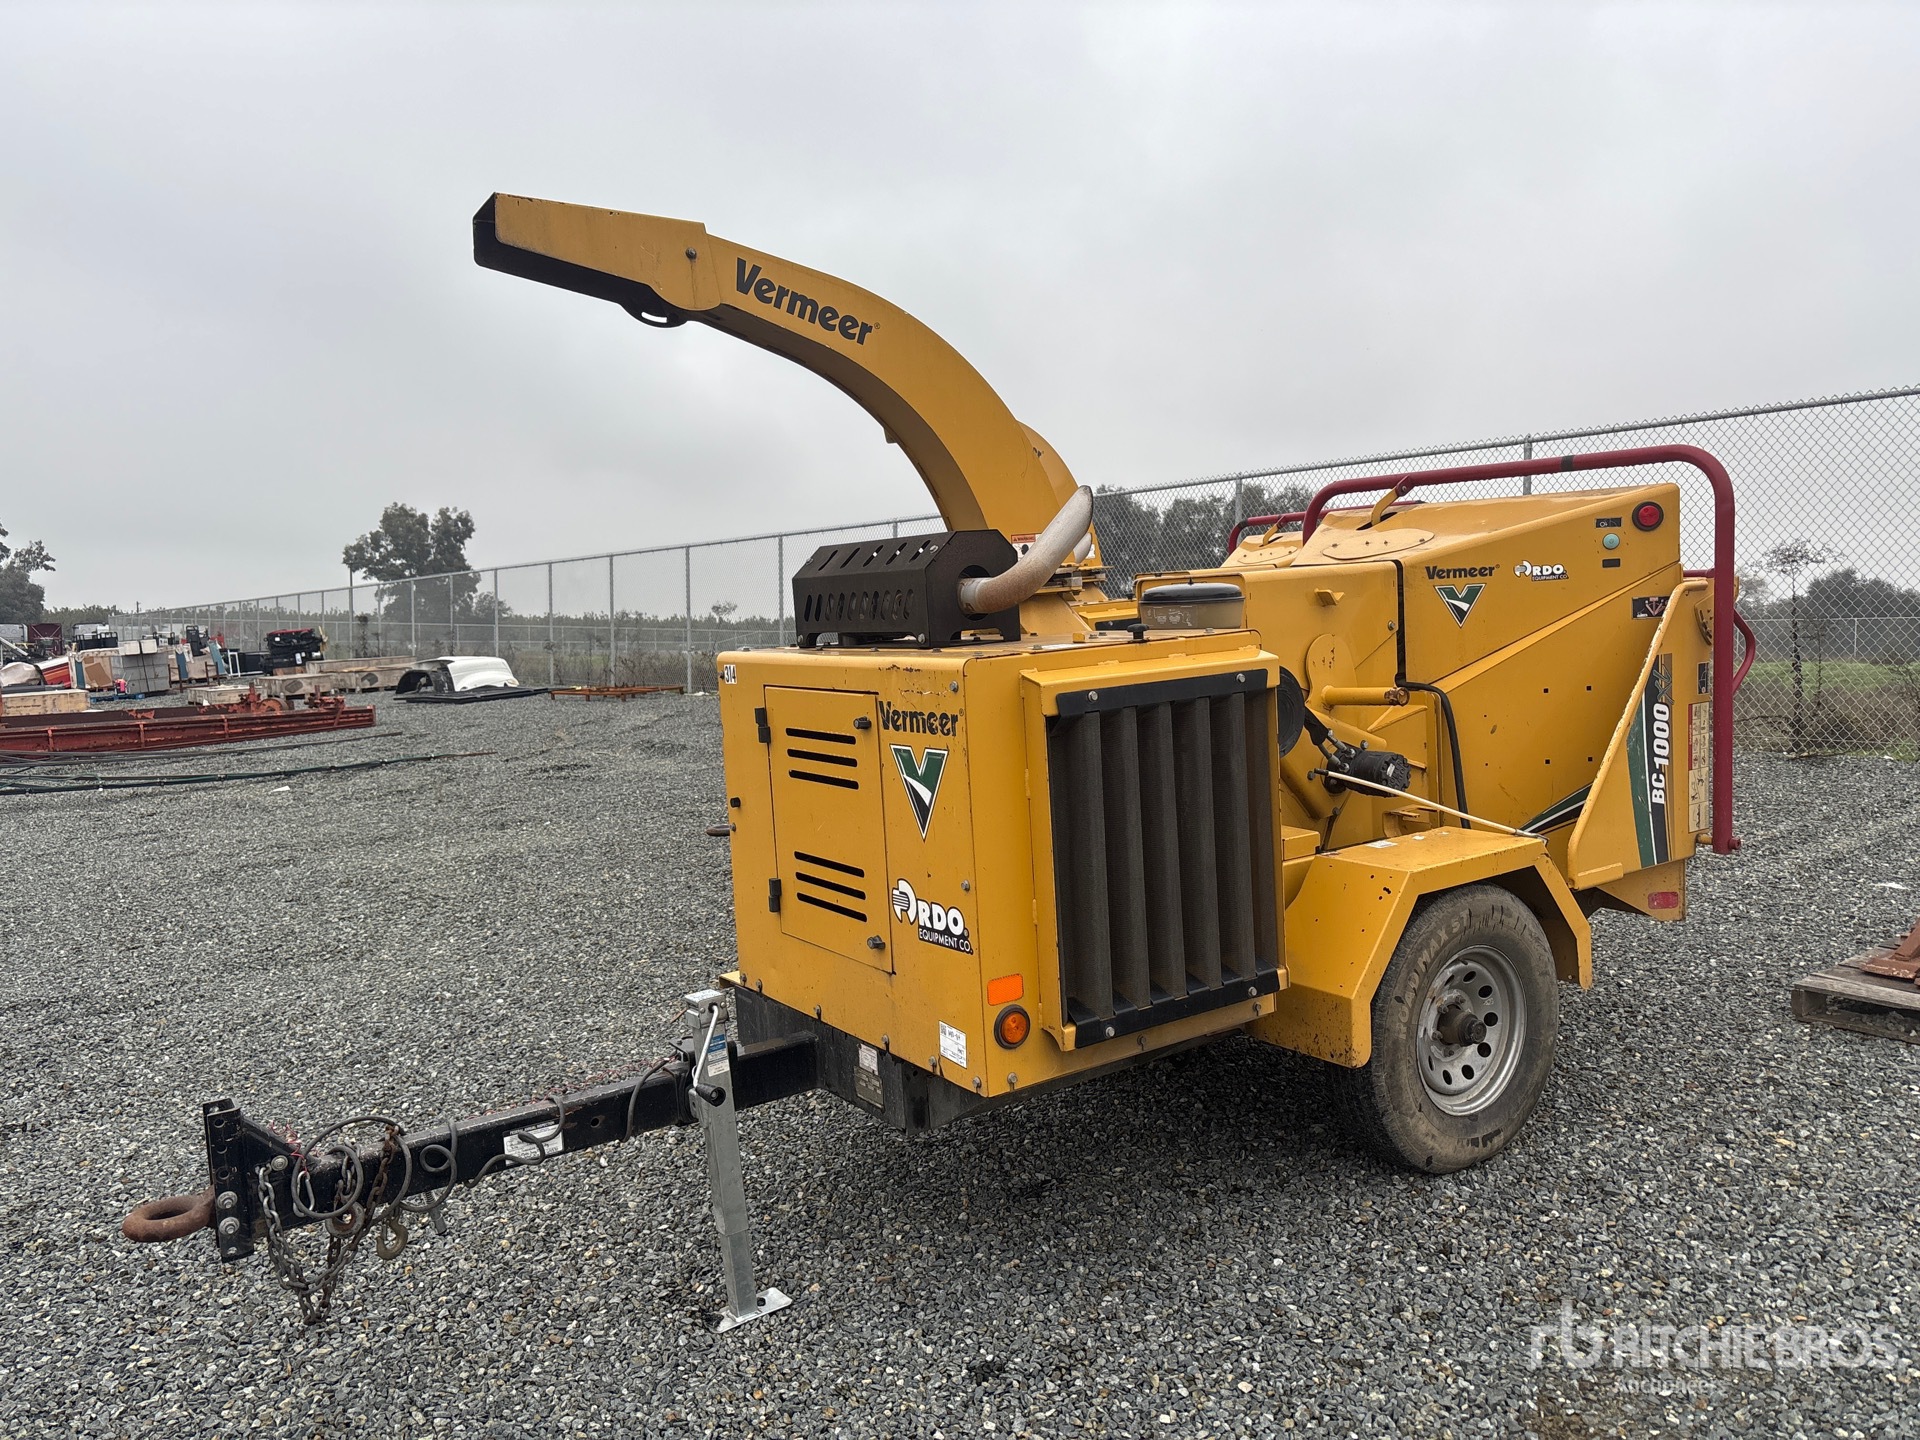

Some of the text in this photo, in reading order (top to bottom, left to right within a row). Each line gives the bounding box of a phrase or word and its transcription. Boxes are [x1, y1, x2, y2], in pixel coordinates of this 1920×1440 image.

[736, 257, 873, 345] Vermeer
[1425, 564, 1495, 580] Vermeer
[878, 701, 959, 737] Vermeer
[918, 928, 958, 948] EQUIPMENT
